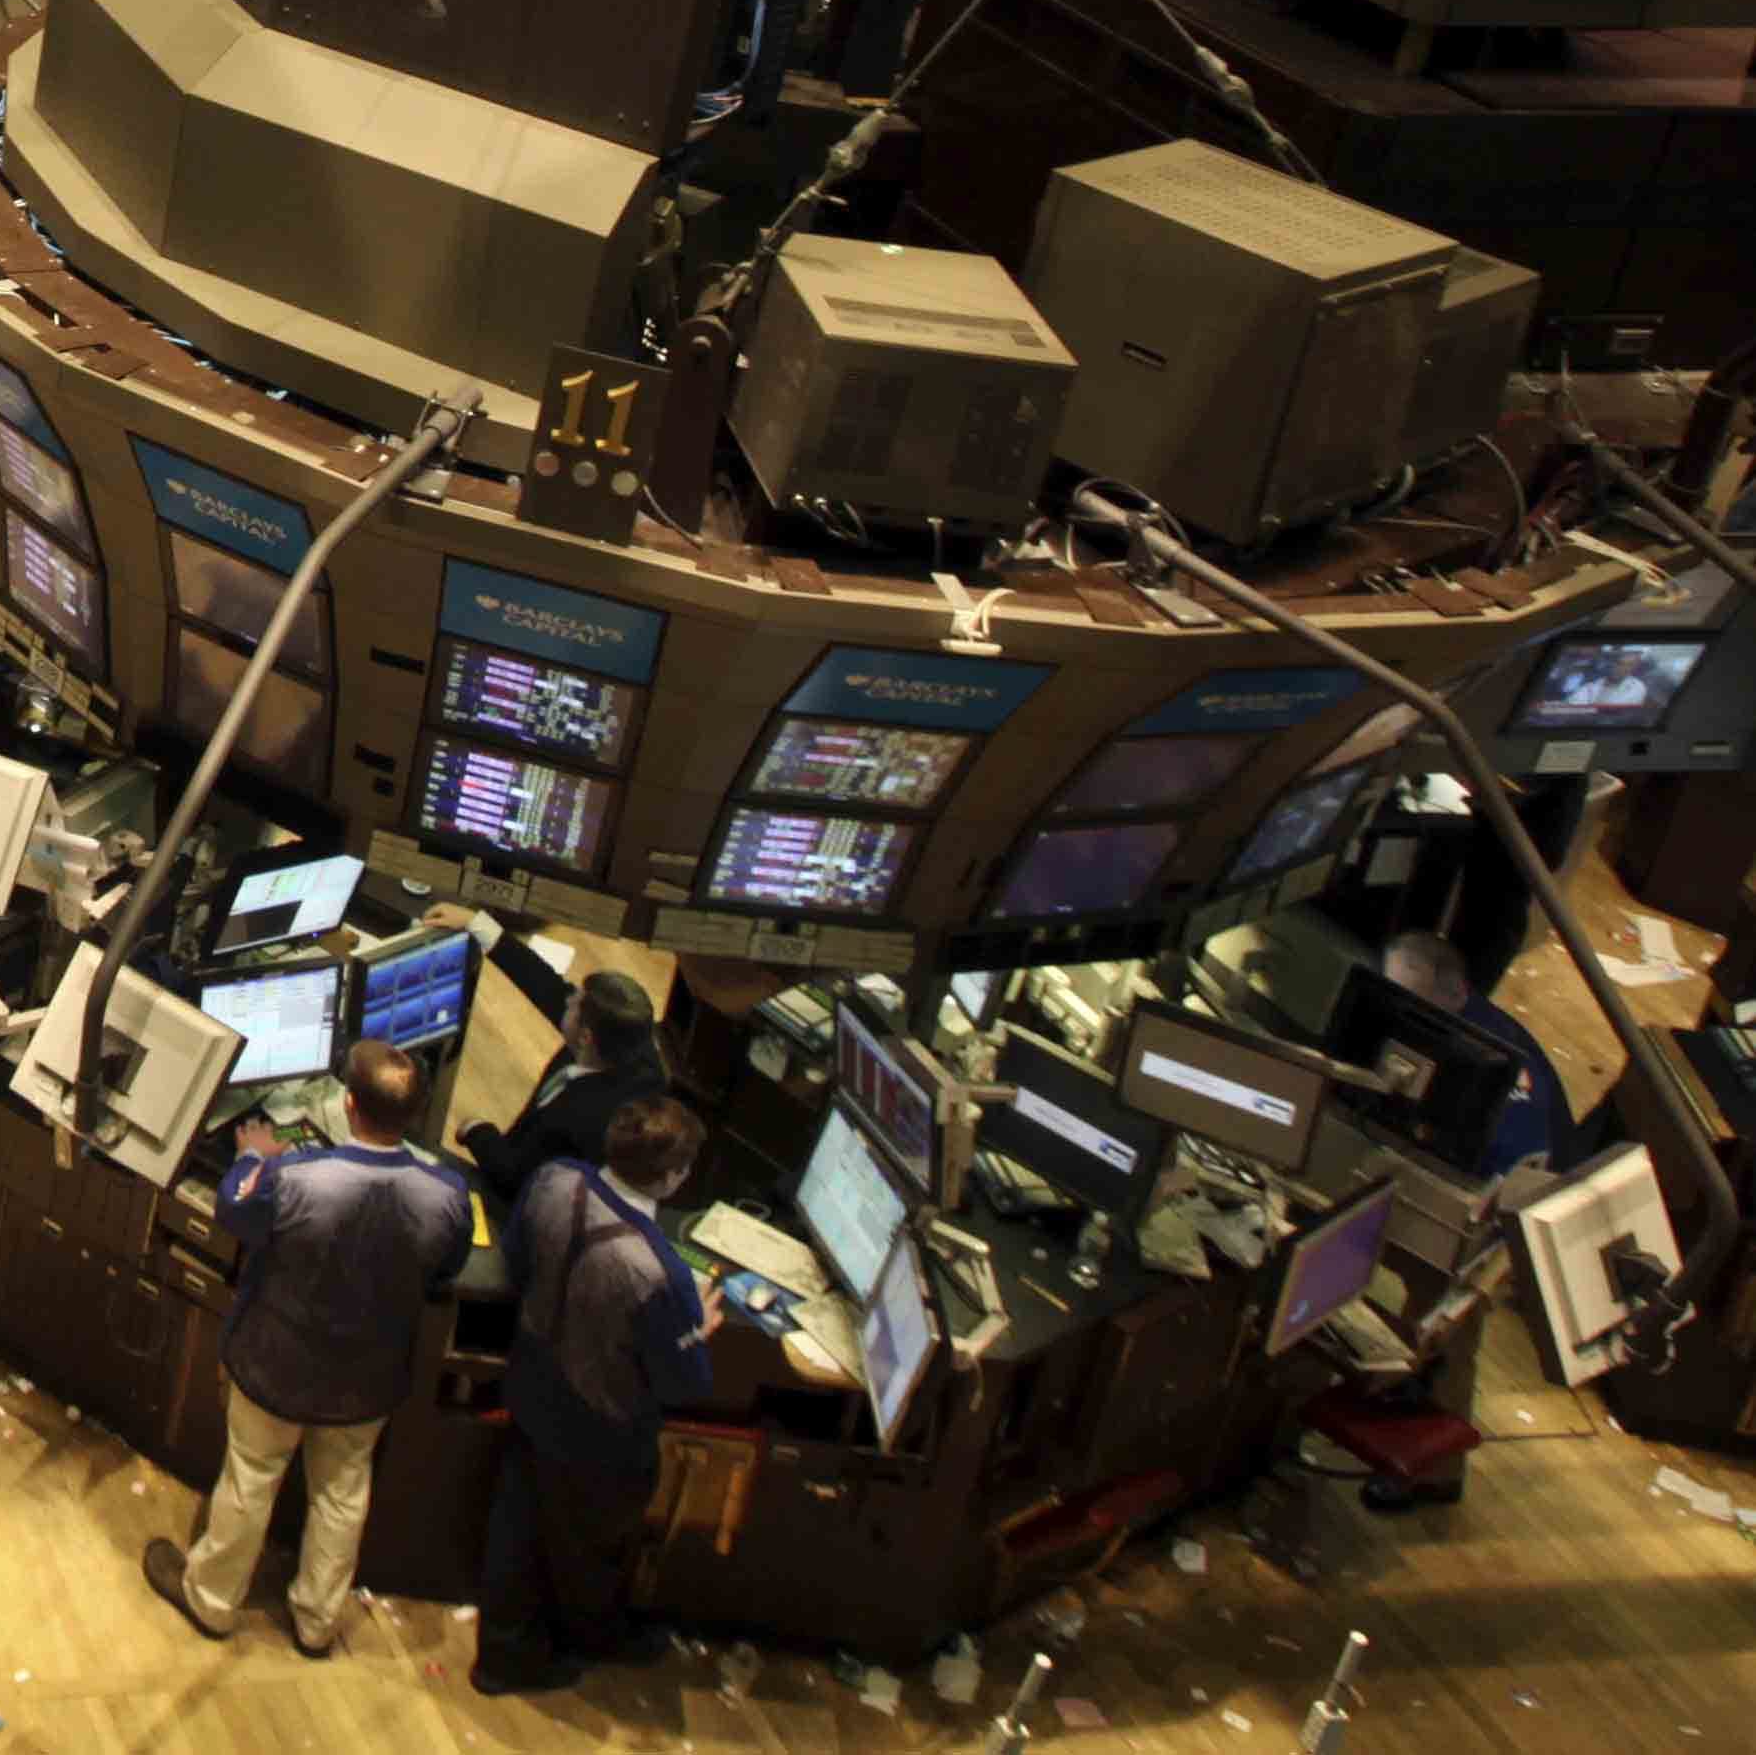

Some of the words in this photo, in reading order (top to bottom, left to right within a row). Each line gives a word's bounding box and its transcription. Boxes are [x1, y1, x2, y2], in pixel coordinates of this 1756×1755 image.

[550, 368, 640, 458] 11
[189, 487, 288, 541] BARCLAYS
[194, 501, 275, 547] CAPITAL
[501, 601, 626, 644] BARCLAYS
[502, 613, 603, 648] CAPITAL
